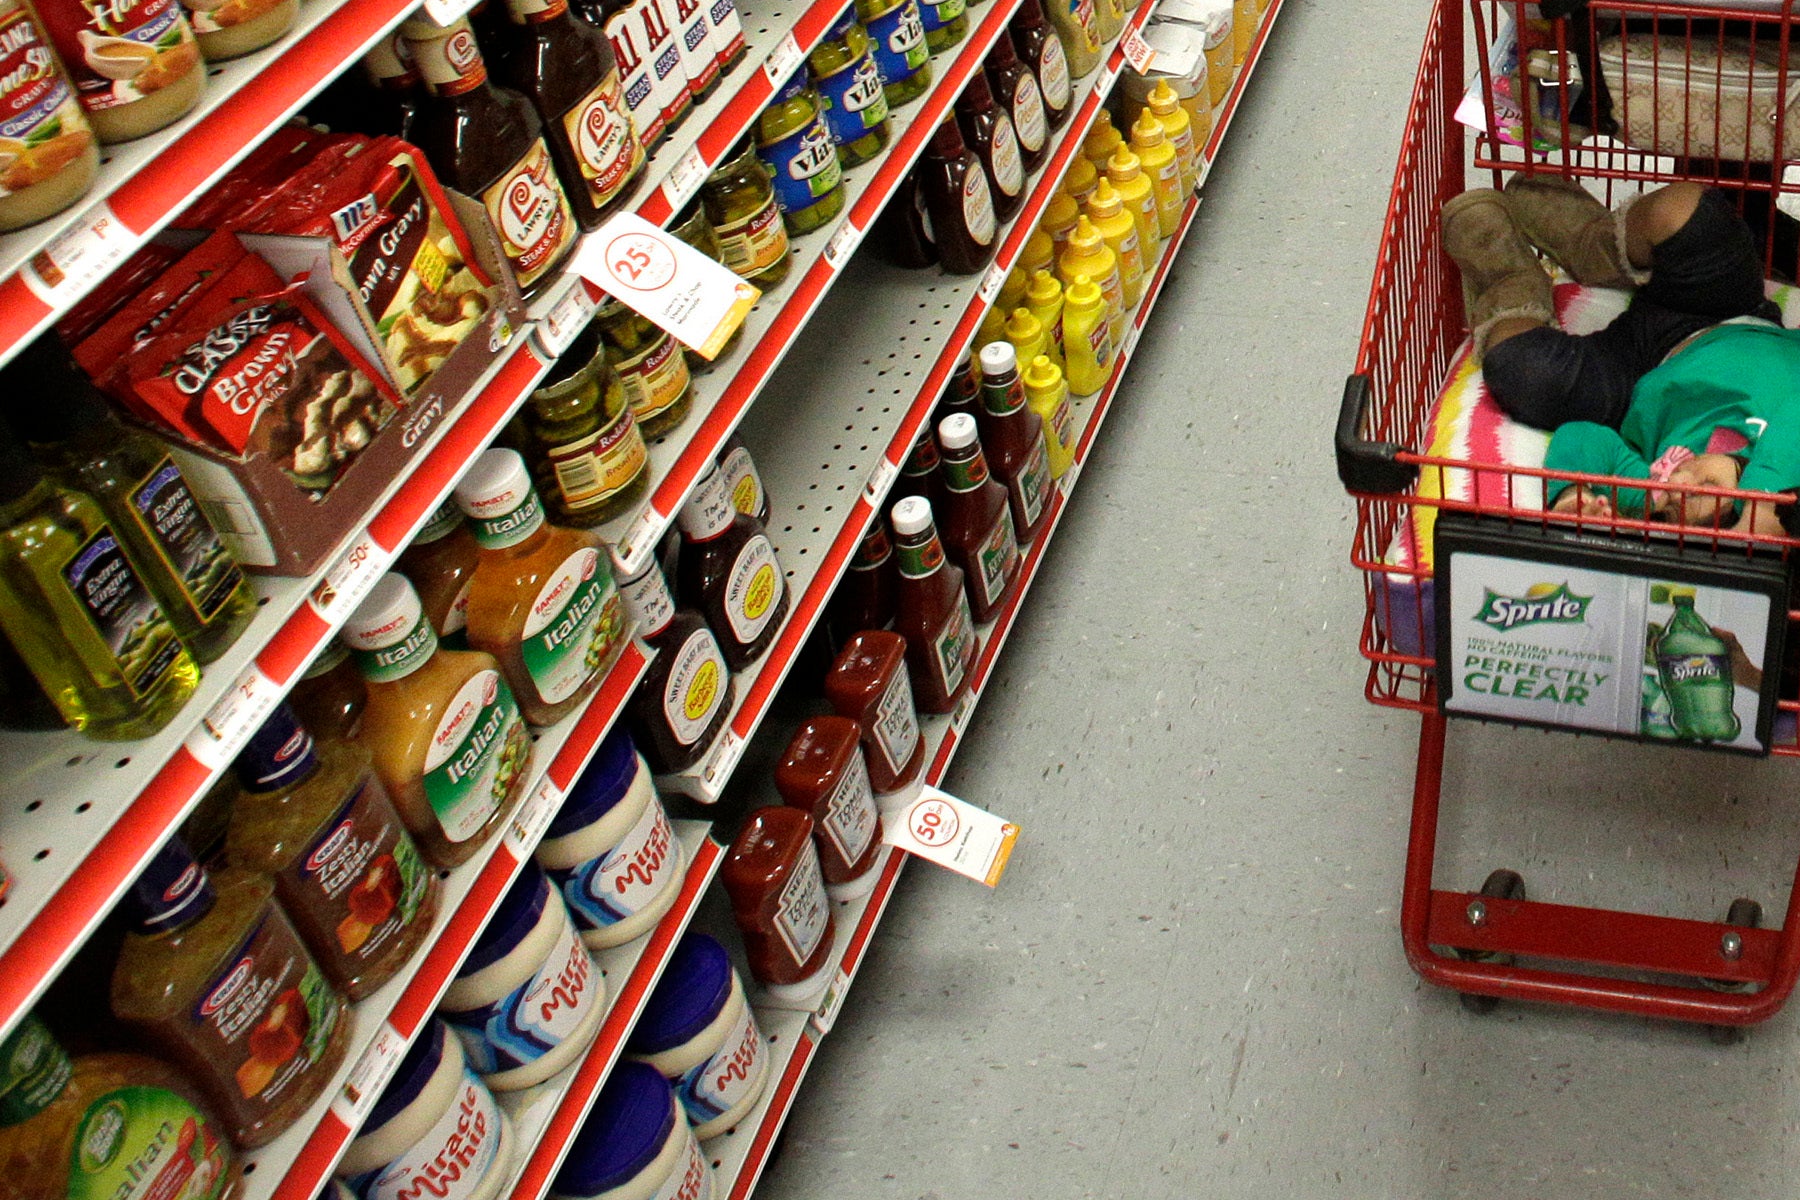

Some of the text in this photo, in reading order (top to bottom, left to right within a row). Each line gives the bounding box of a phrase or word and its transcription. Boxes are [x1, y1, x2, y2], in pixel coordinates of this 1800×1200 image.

[594, 125, 621, 164] LAWRY'S
[596, 166, 619, 188] STEAK
[379, 197, 423, 257] Gravy
[517, 196, 549, 240] LAWRY'S
[520, 244, 545, 267] STEAK
[547, 212, 562, 239] CHOP
[615, 247, 651, 280] 25
[212, 331, 291, 405] Brown
[230, 345, 299, 415] Gravy
[402, 396, 444, 449] Gravy
[153, 486, 186, 524] Extra
[157, 501, 195, 535] Virgin
[484, 490, 539, 538] Italian
[86, 559, 122, 595] Extra
[90, 572, 132, 610] Virgin
[541, 580, 602, 653] Italian
[1485, 594, 1581, 627] Sprite
[375, 623, 431, 669] Italian
[1484, 646, 1549, 661] CAFFEINE
[1497, 640, 1553, 654] NATURAL
[1557, 649, 1615, 664] FLAVORS
[1463, 672, 1590, 707] CLEAR
[1464, 655, 1609, 687] PERFECTLY
[1672, 664, 1718, 681] Sprite
[445, 704, 506, 789] Italian
[917, 810, 942, 841] 50
[316, 833, 361, 879] Zesty
[320, 841, 375, 898] Italian
[212, 974, 259, 1026] Zesty
[218, 977, 276, 1044] Italian
[400, 1083, 480, 1200] Miracle
[436, 1114, 488, 1195] Whip
